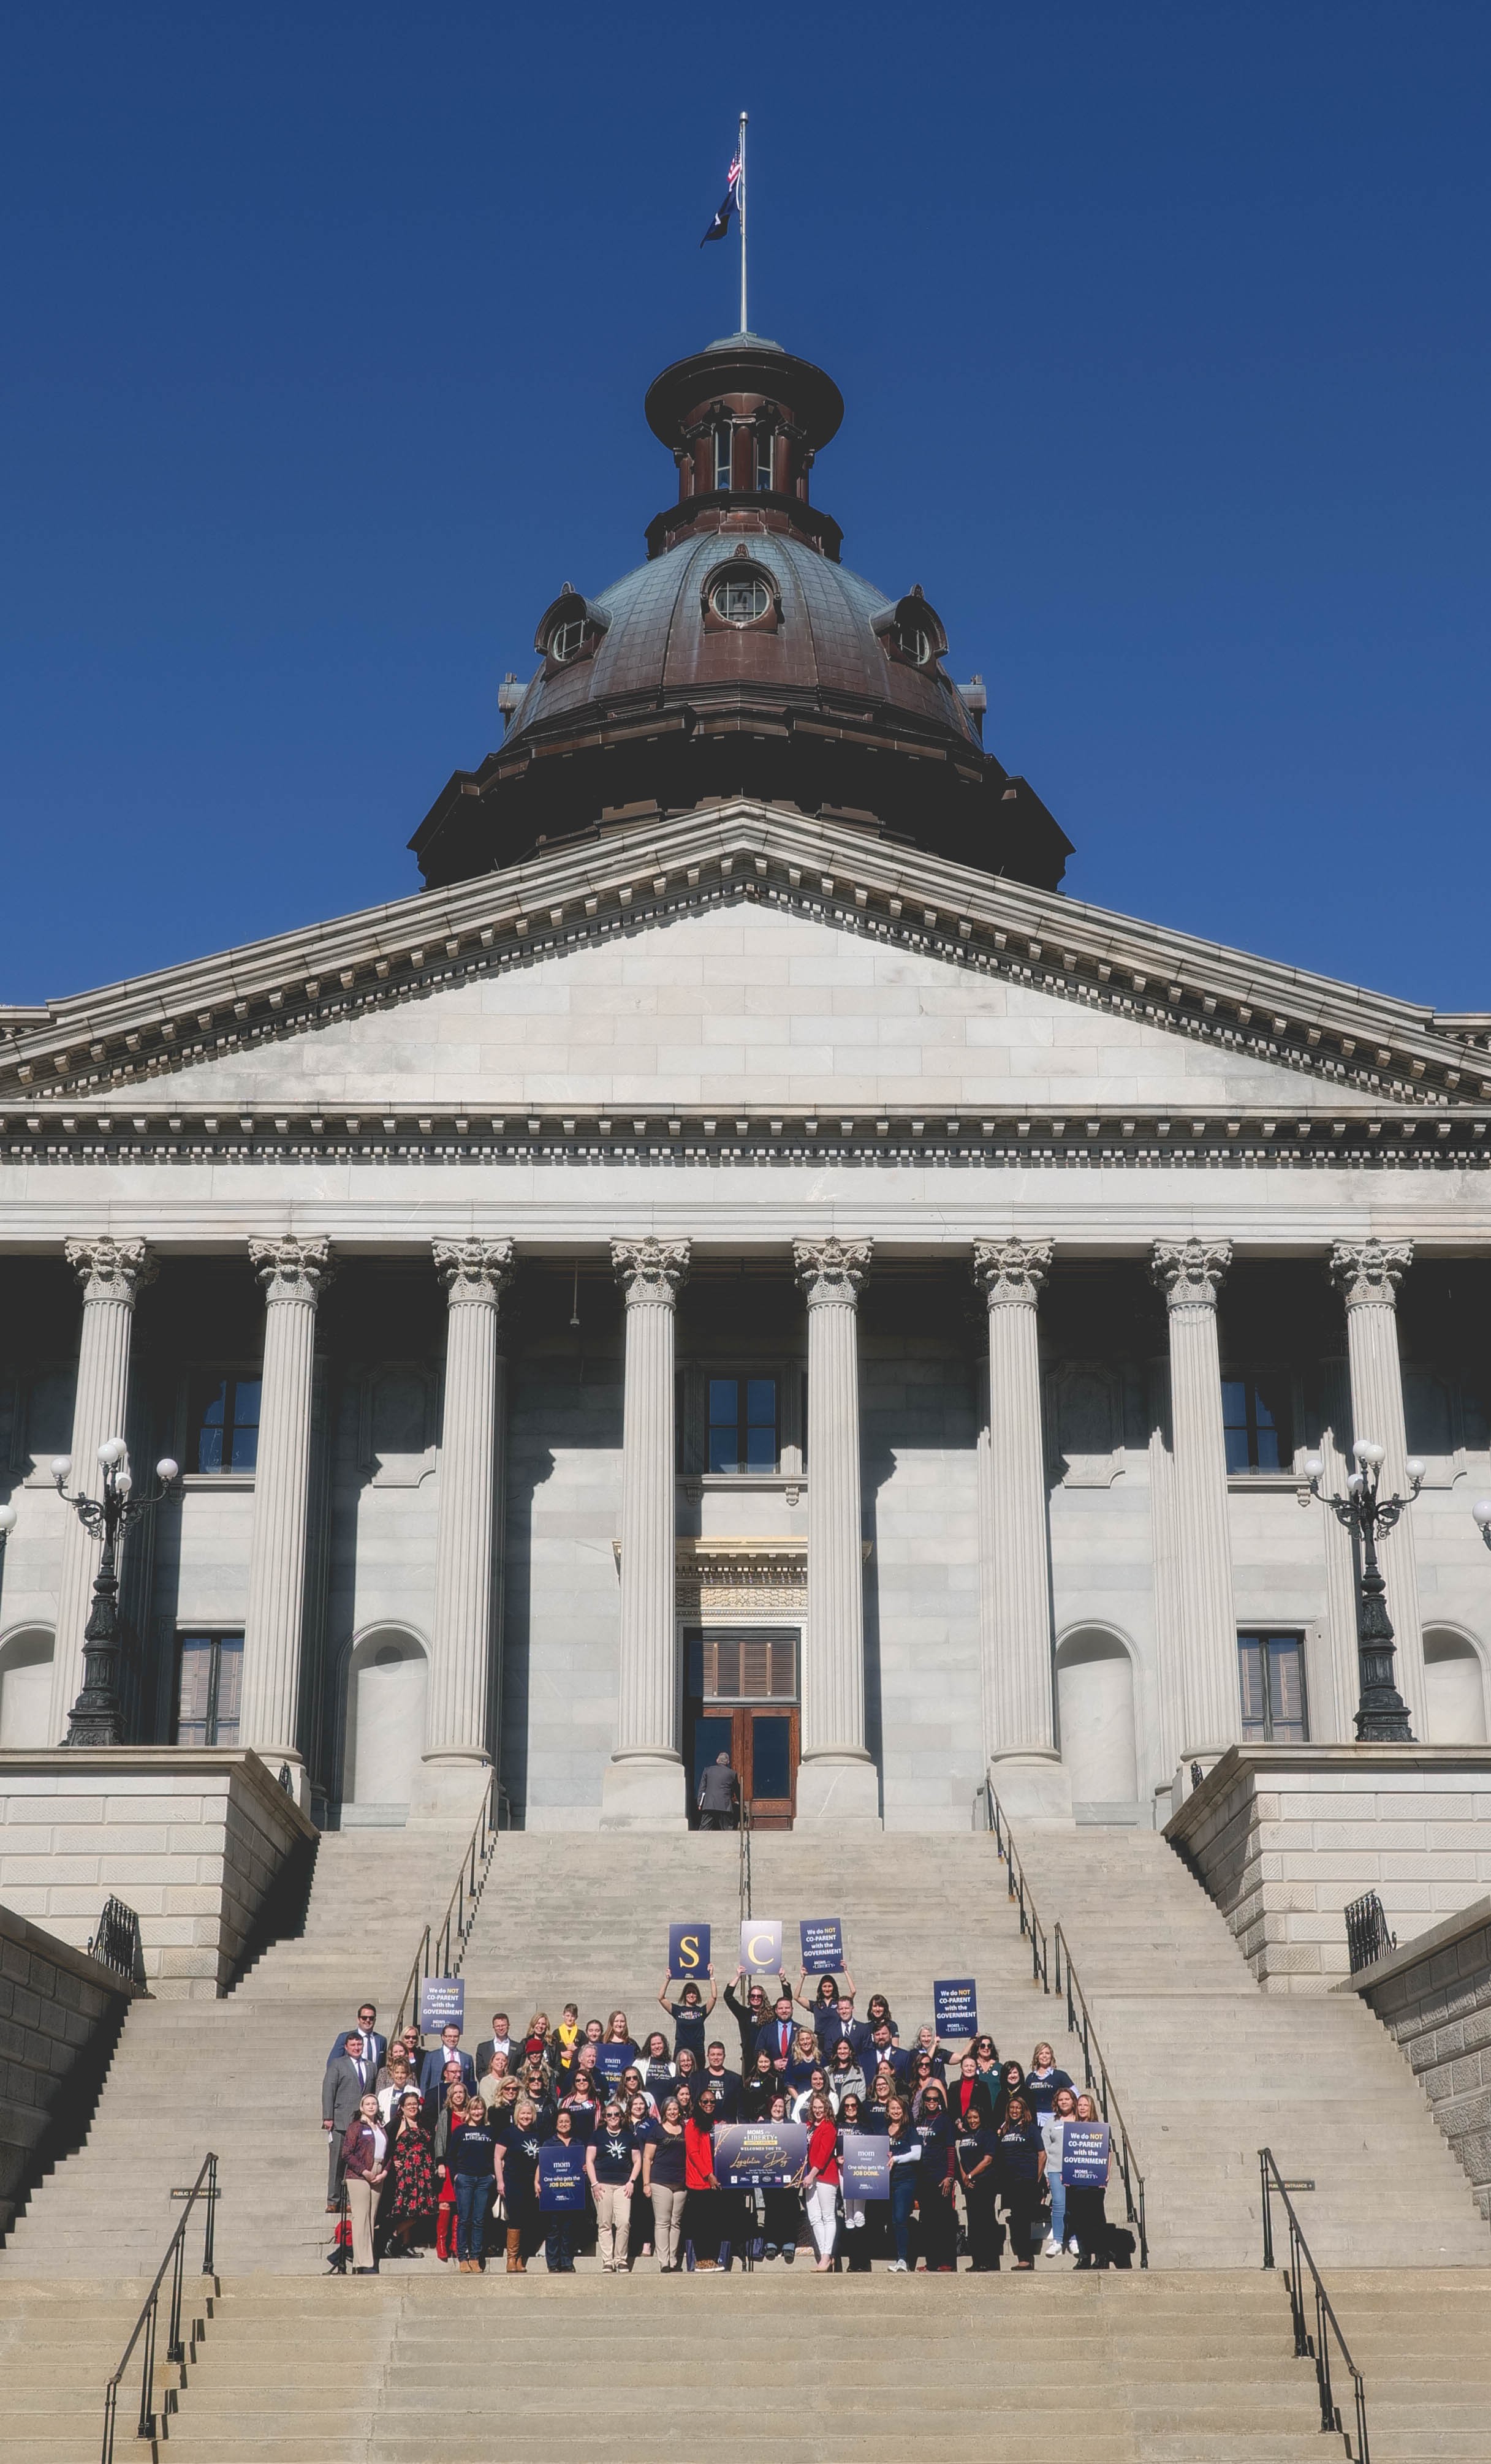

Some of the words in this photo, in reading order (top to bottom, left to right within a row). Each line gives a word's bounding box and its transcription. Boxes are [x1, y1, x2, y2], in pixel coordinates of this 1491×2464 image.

[679, 1936, 700, 1968] S
[748, 1935, 775, 1965] C
[804, 1948, 841, 1957] GOVERNMENT
[763, 2150, 792, 2168] Day
